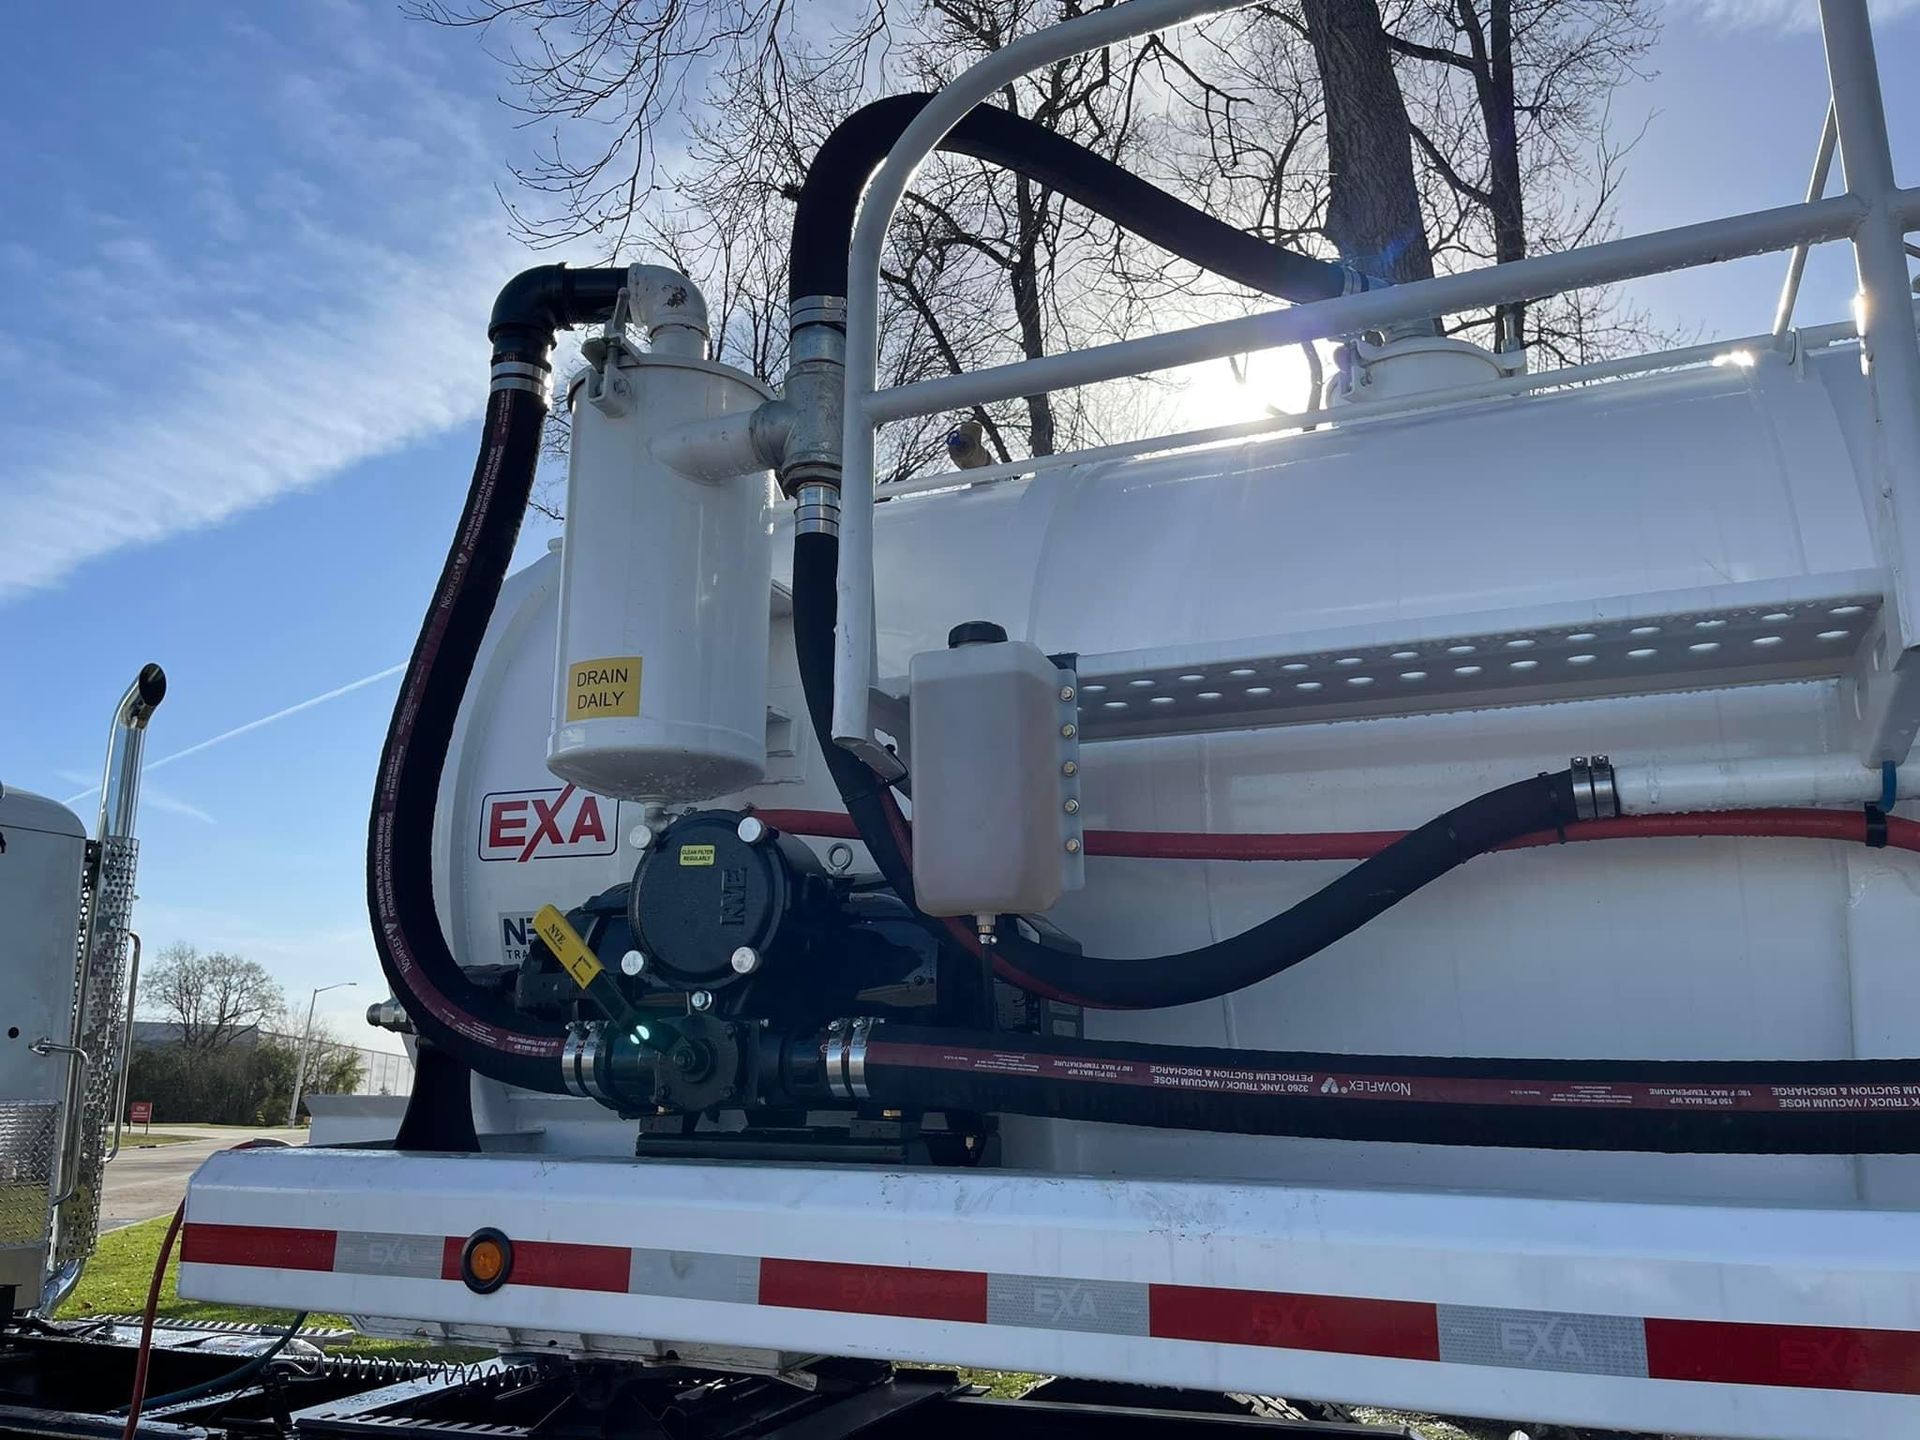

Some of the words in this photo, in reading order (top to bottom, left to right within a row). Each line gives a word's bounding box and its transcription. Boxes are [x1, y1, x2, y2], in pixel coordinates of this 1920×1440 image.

[577, 668, 628, 687] DRAIN
[577, 691, 625, 710] DAILY
[489, 782, 606, 862] EXA
[1149, 1065, 1202, 1076] DISCHARGE
[1213, 1069, 1254, 1079] SUCTION
[1152, 1075, 1178, 1085] HOSE
[1255, 1071, 1313, 1082] PETROLEUM
[1180, 1077, 1219, 1088] VACUUM
[1226, 1081, 1258, 1090] TRUCK
[1259, 1082, 1286, 1092] TANK
[1286, 1083, 1309, 1093] 3260
[1348, 1079, 1410, 1095] NOVAFLEX
[1770, 1087, 1836, 1095] DISCHARGE
[1850, 1086, 1900, 1095] SUCTION
[1778, 1098, 1810, 1107] HOSE
[1812, 1098, 1861, 1107] VACUUM
[1869, 1098, 1908, 1107] TRUCK
[368, 1242, 411, 1266] EXA
[1032, 1283, 1099, 1321] EXA
[1500, 1317, 1585, 1362] EXA
[1779, 1333, 1868, 1377] EXA
